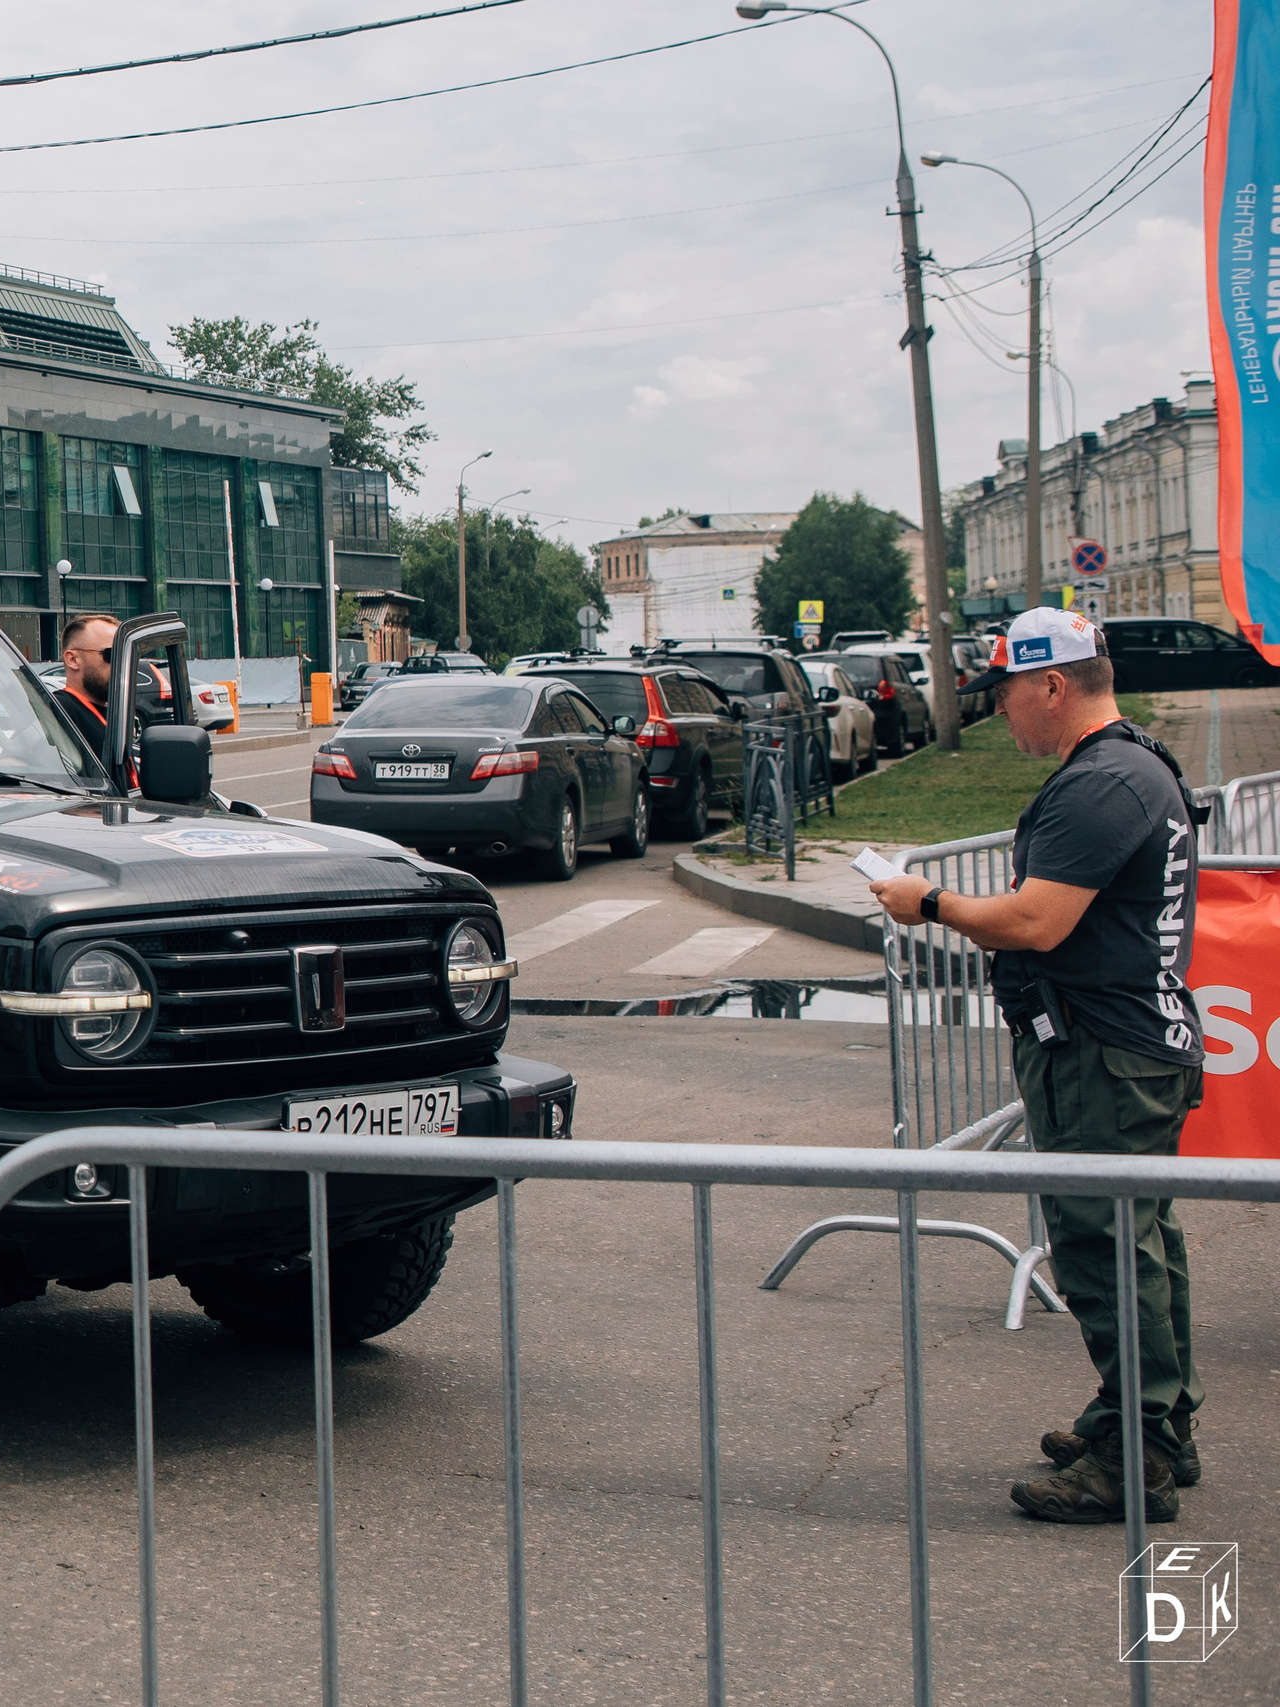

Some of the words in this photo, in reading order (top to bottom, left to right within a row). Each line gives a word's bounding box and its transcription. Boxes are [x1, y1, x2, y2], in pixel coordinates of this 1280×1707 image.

[433, 764, 446, 774] 38
[1156, 817, 1192, 1050] SECURITY
[411, 1091, 451, 1124] 797
[420, 1122, 440, 1135] RUS
